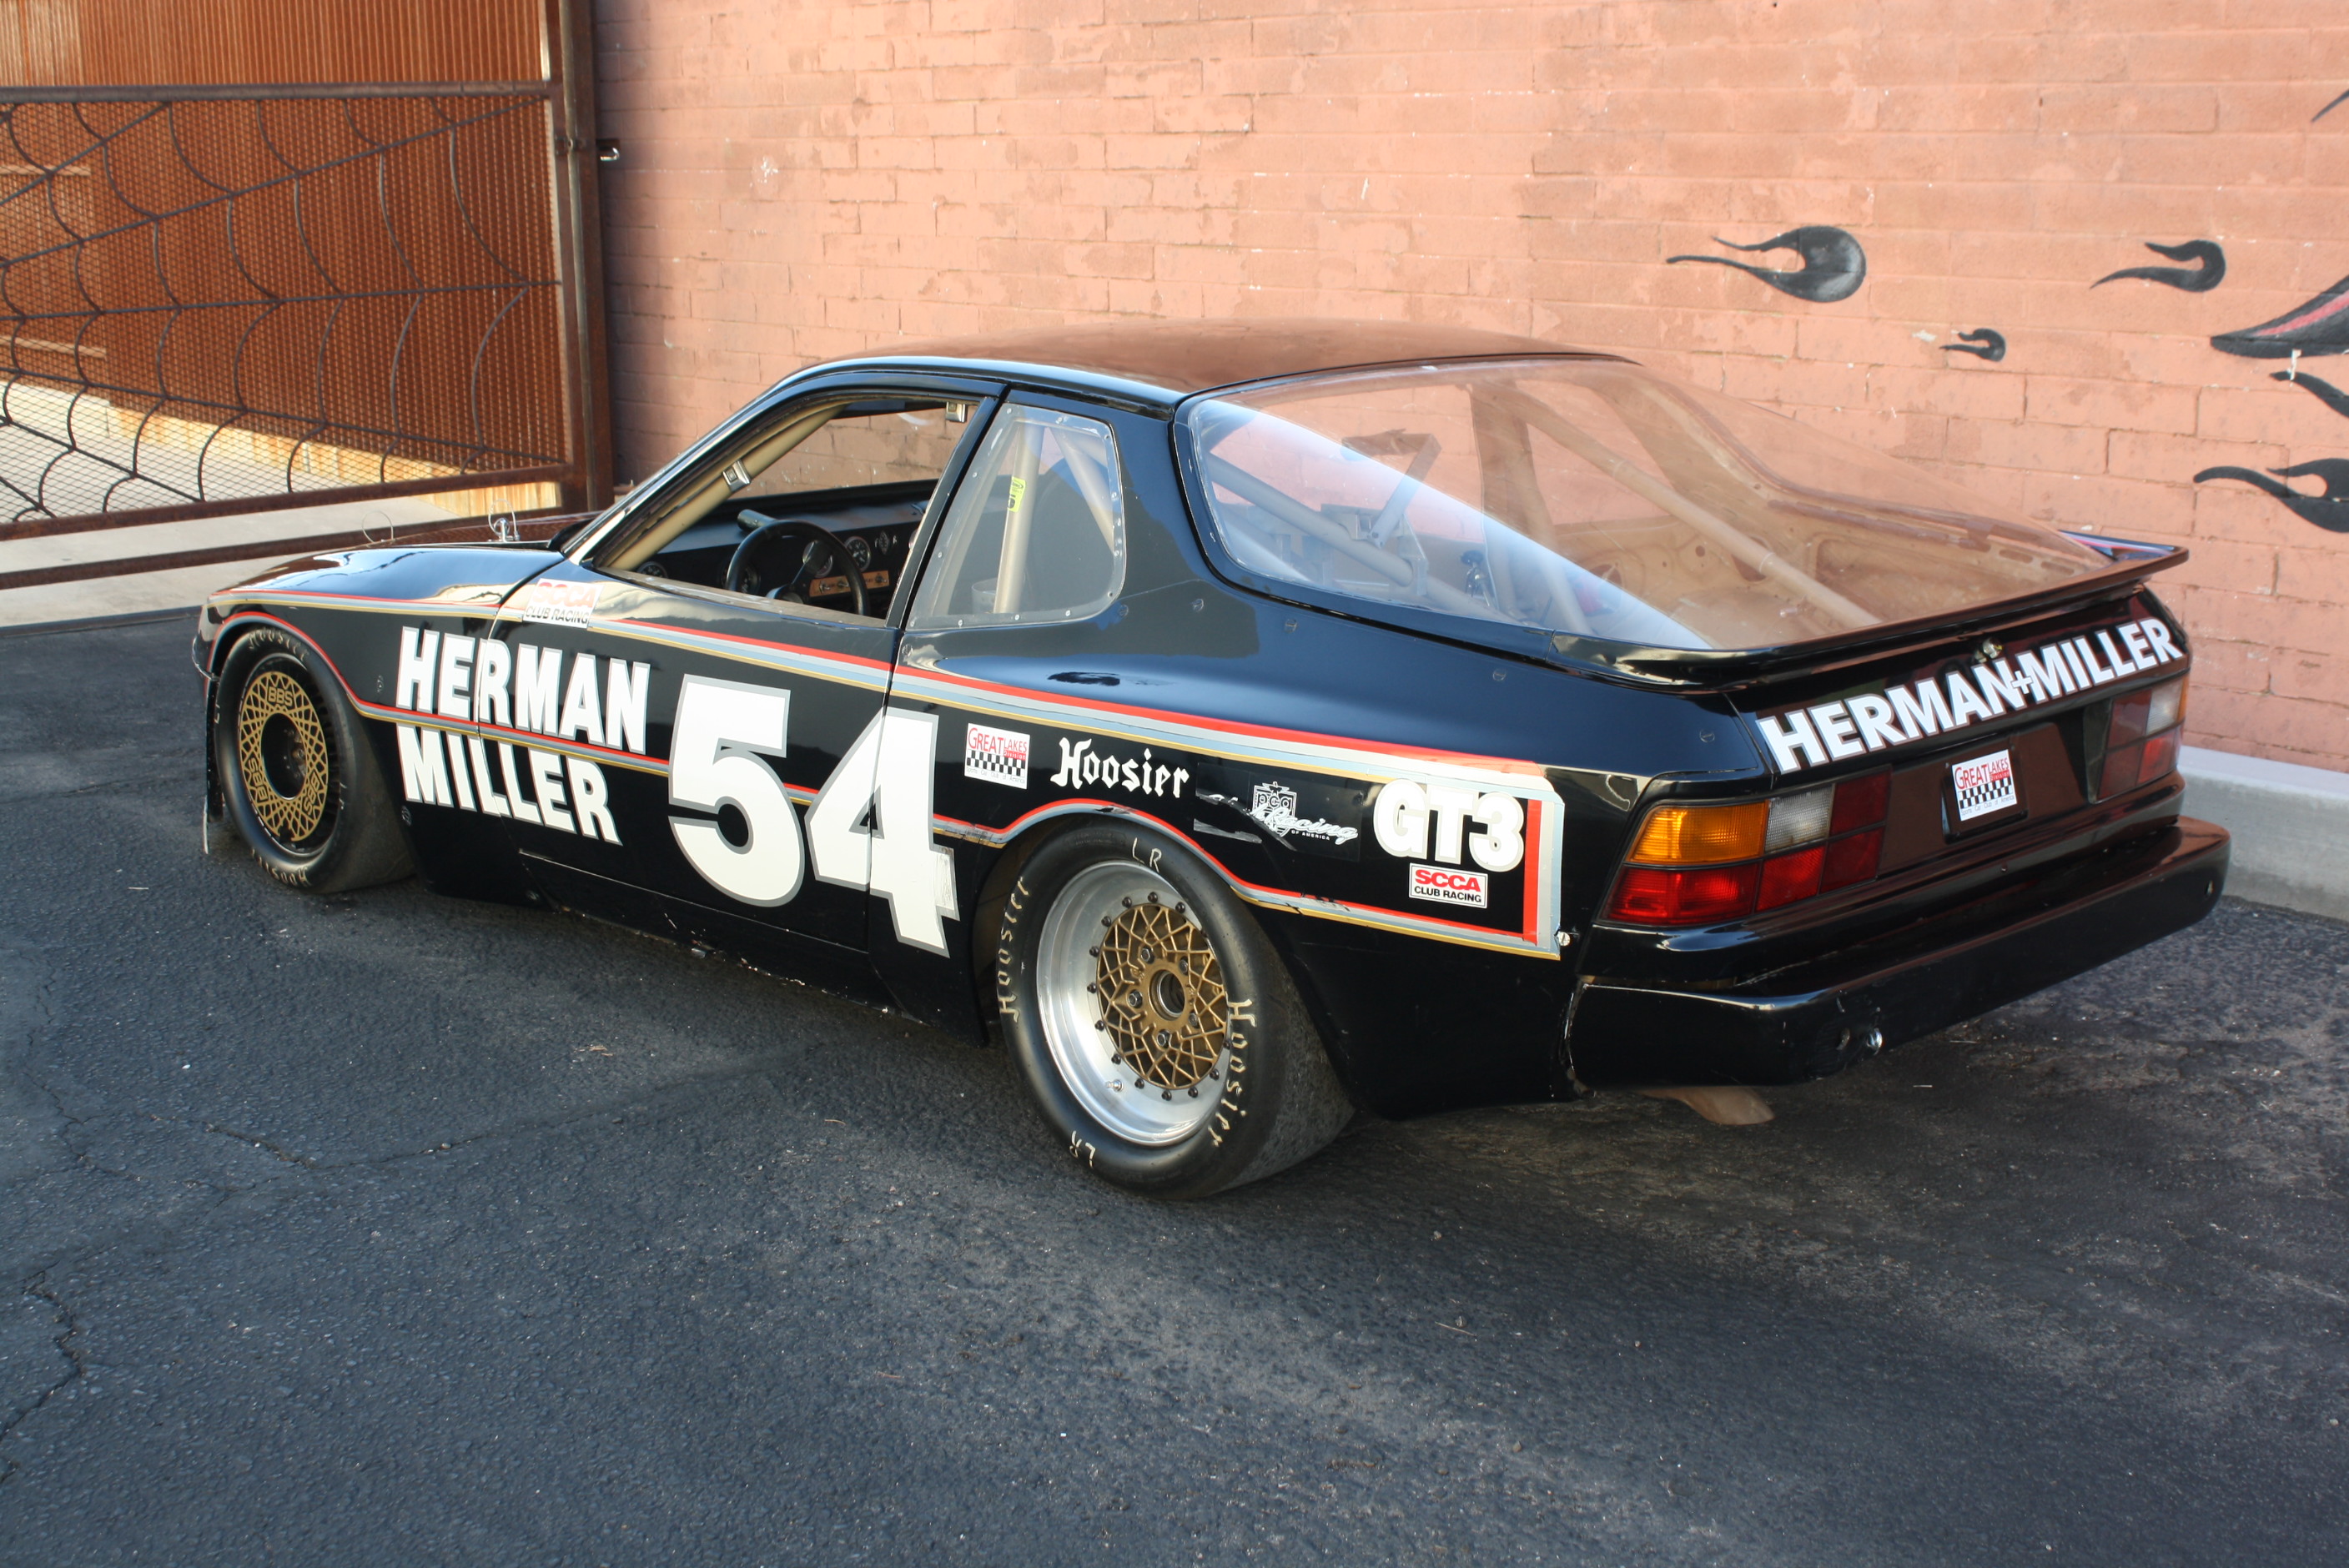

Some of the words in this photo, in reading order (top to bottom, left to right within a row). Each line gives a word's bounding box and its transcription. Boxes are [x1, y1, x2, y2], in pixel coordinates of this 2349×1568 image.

[526, 606, 551, 619] CLUB
[551, 608, 590, 625] RACING
[268, 686, 293, 707] BBS
[396, 626, 651, 756] HERMAN
[249, 757, 269, 802] BBS
[396, 722, 623, 846] MILLER
[1050, 737, 1190, 798] Hoosier
[303, 776, 321, 816] BBS
[667, 674, 959, 957] 54
[1301, 832, 1330, 842] AMERICA
[1373, 778, 1524, 872] GT3
[1132, 837, 1162, 873] LR
[1414, 886, 1441, 897] CLUB
[1443, 890, 1482, 903] RACING
[1415, 869, 1481, 892] SCCA
